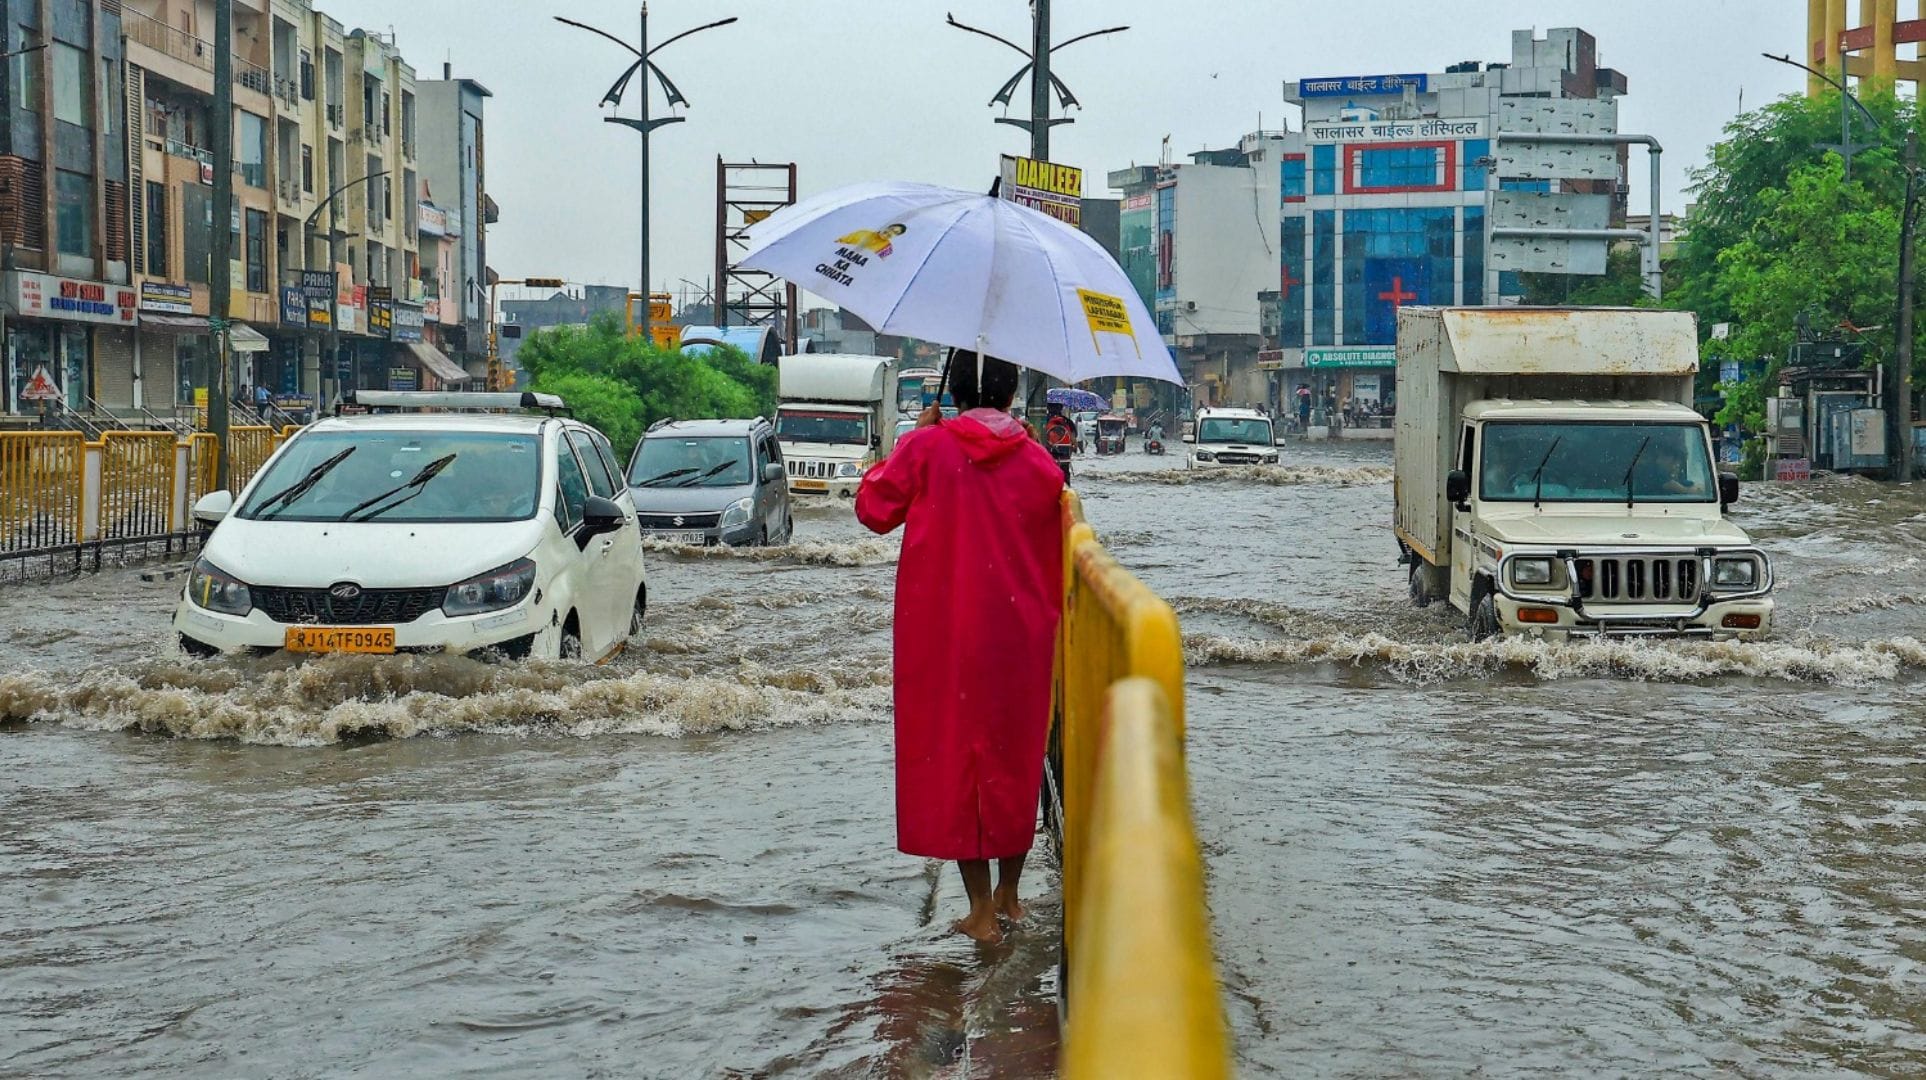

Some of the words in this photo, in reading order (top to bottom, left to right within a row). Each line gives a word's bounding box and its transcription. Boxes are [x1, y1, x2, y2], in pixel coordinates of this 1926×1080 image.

[1304, 81, 1343, 92] सालासर
[1313, 126, 1365, 140] सालासर
[1371, 121, 1414, 139] चाईल्ड
[1419, 119, 1478, 136] हॉस्पिटल
[1016, 158, 1082, 197] DAHLEEZ
[833, 258, 850, 272] KA
[834, 246, 869, 267] MAMA
[815, 263, 854, 287] CHHATA
[1322, 352, 1360, 361] ABSOLUTE
[297, 632, 393, 648] RJ14TF0945
